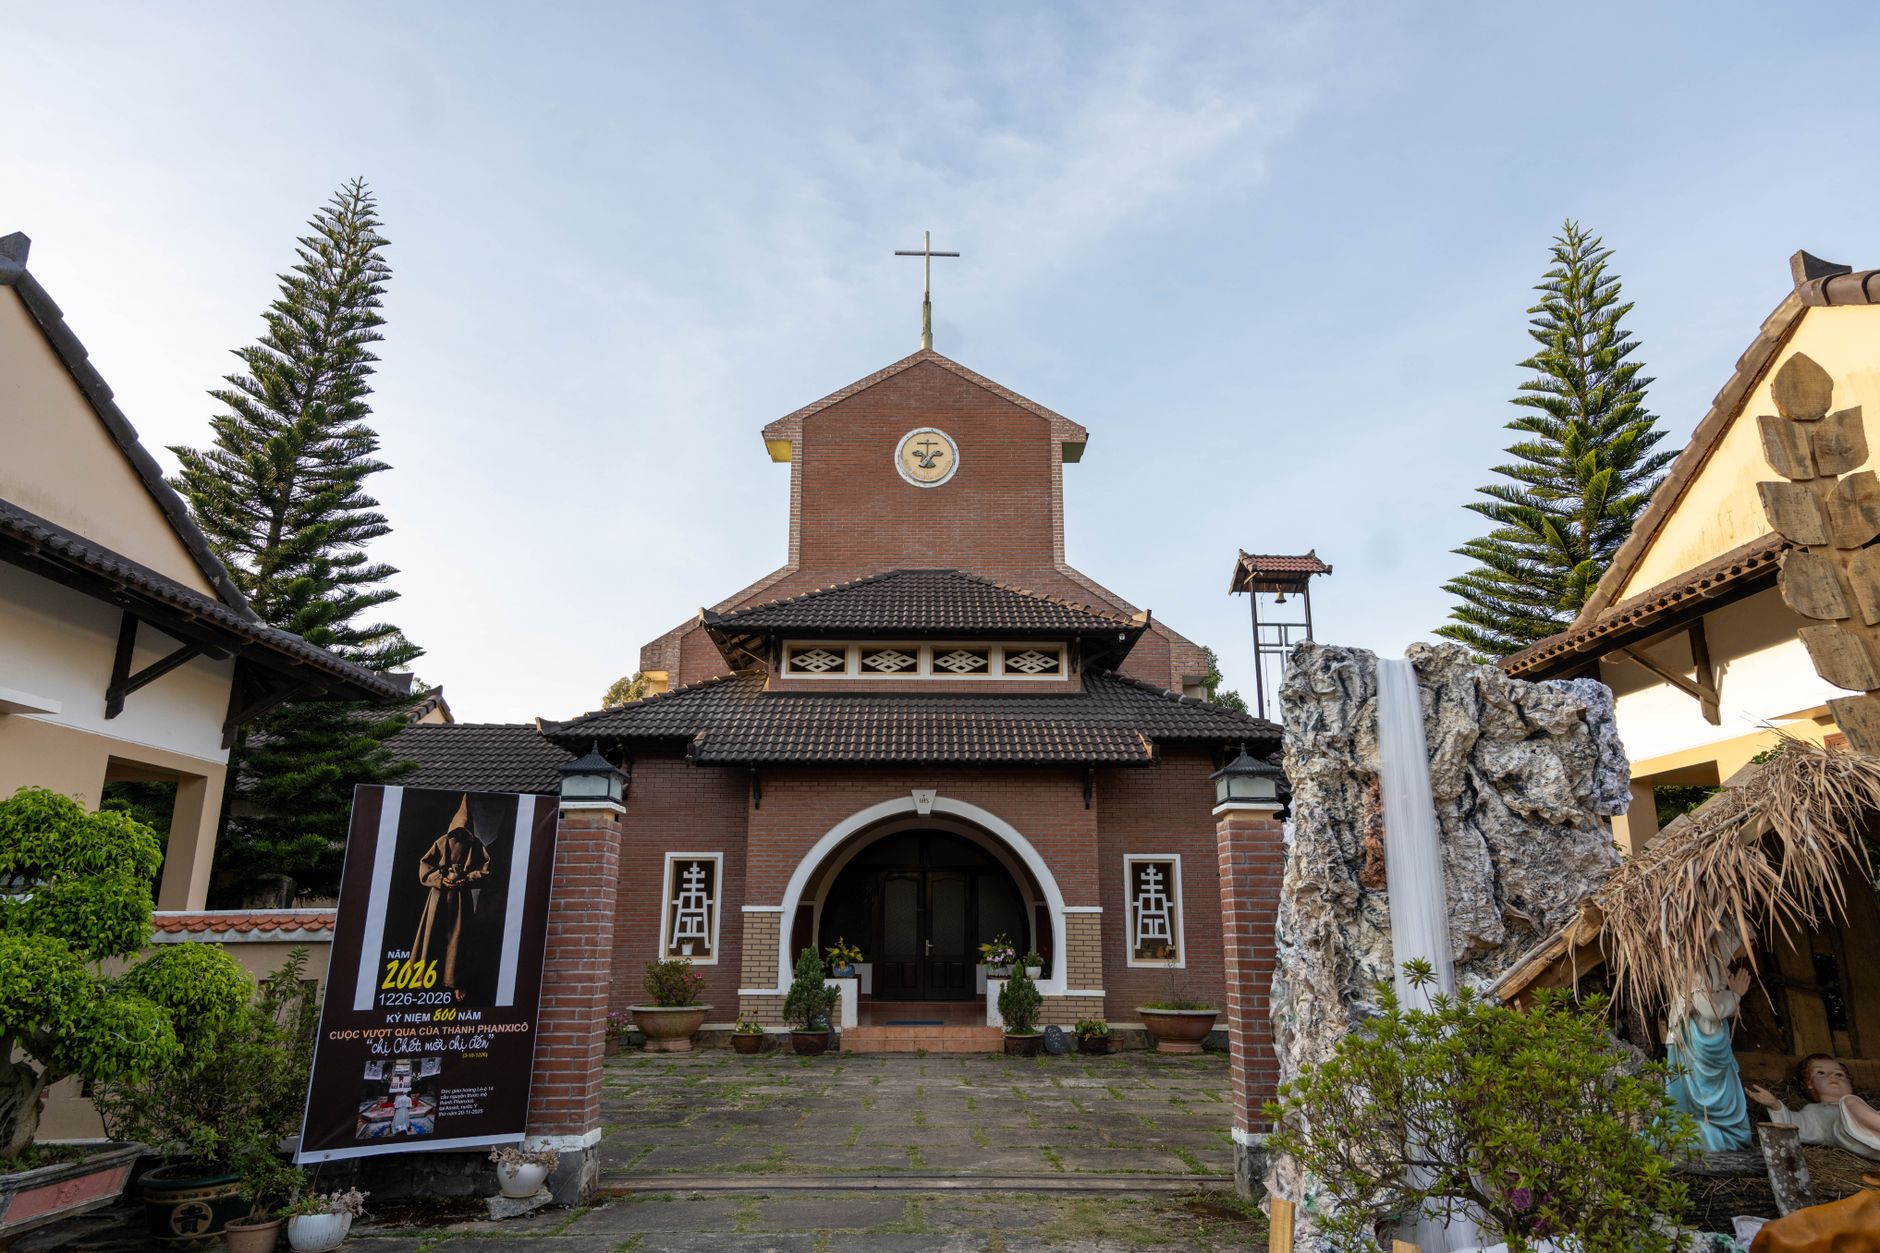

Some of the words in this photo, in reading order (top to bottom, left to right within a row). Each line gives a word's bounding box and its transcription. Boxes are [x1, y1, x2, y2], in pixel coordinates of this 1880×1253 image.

[387, 949, 410, 959] NĂM
[381, 959, 438, 989] 2026
[378, 991, 452, 1006] 1226-2026
[403, 1012, 431, 1024] NIỆM
[433, 1008, 457, 1021] 800
[457, 1010, 481, 1021] NĂM
[362, 1028, 392, 1040] VƯỢT
[394, 1027, 416, 1037] QUA
[418, 1025, 440, 1036] CỦA
[442, 1024, 475, 1035] THÁNH
[477, 1021, 529, 1033] PHANXICÔ
